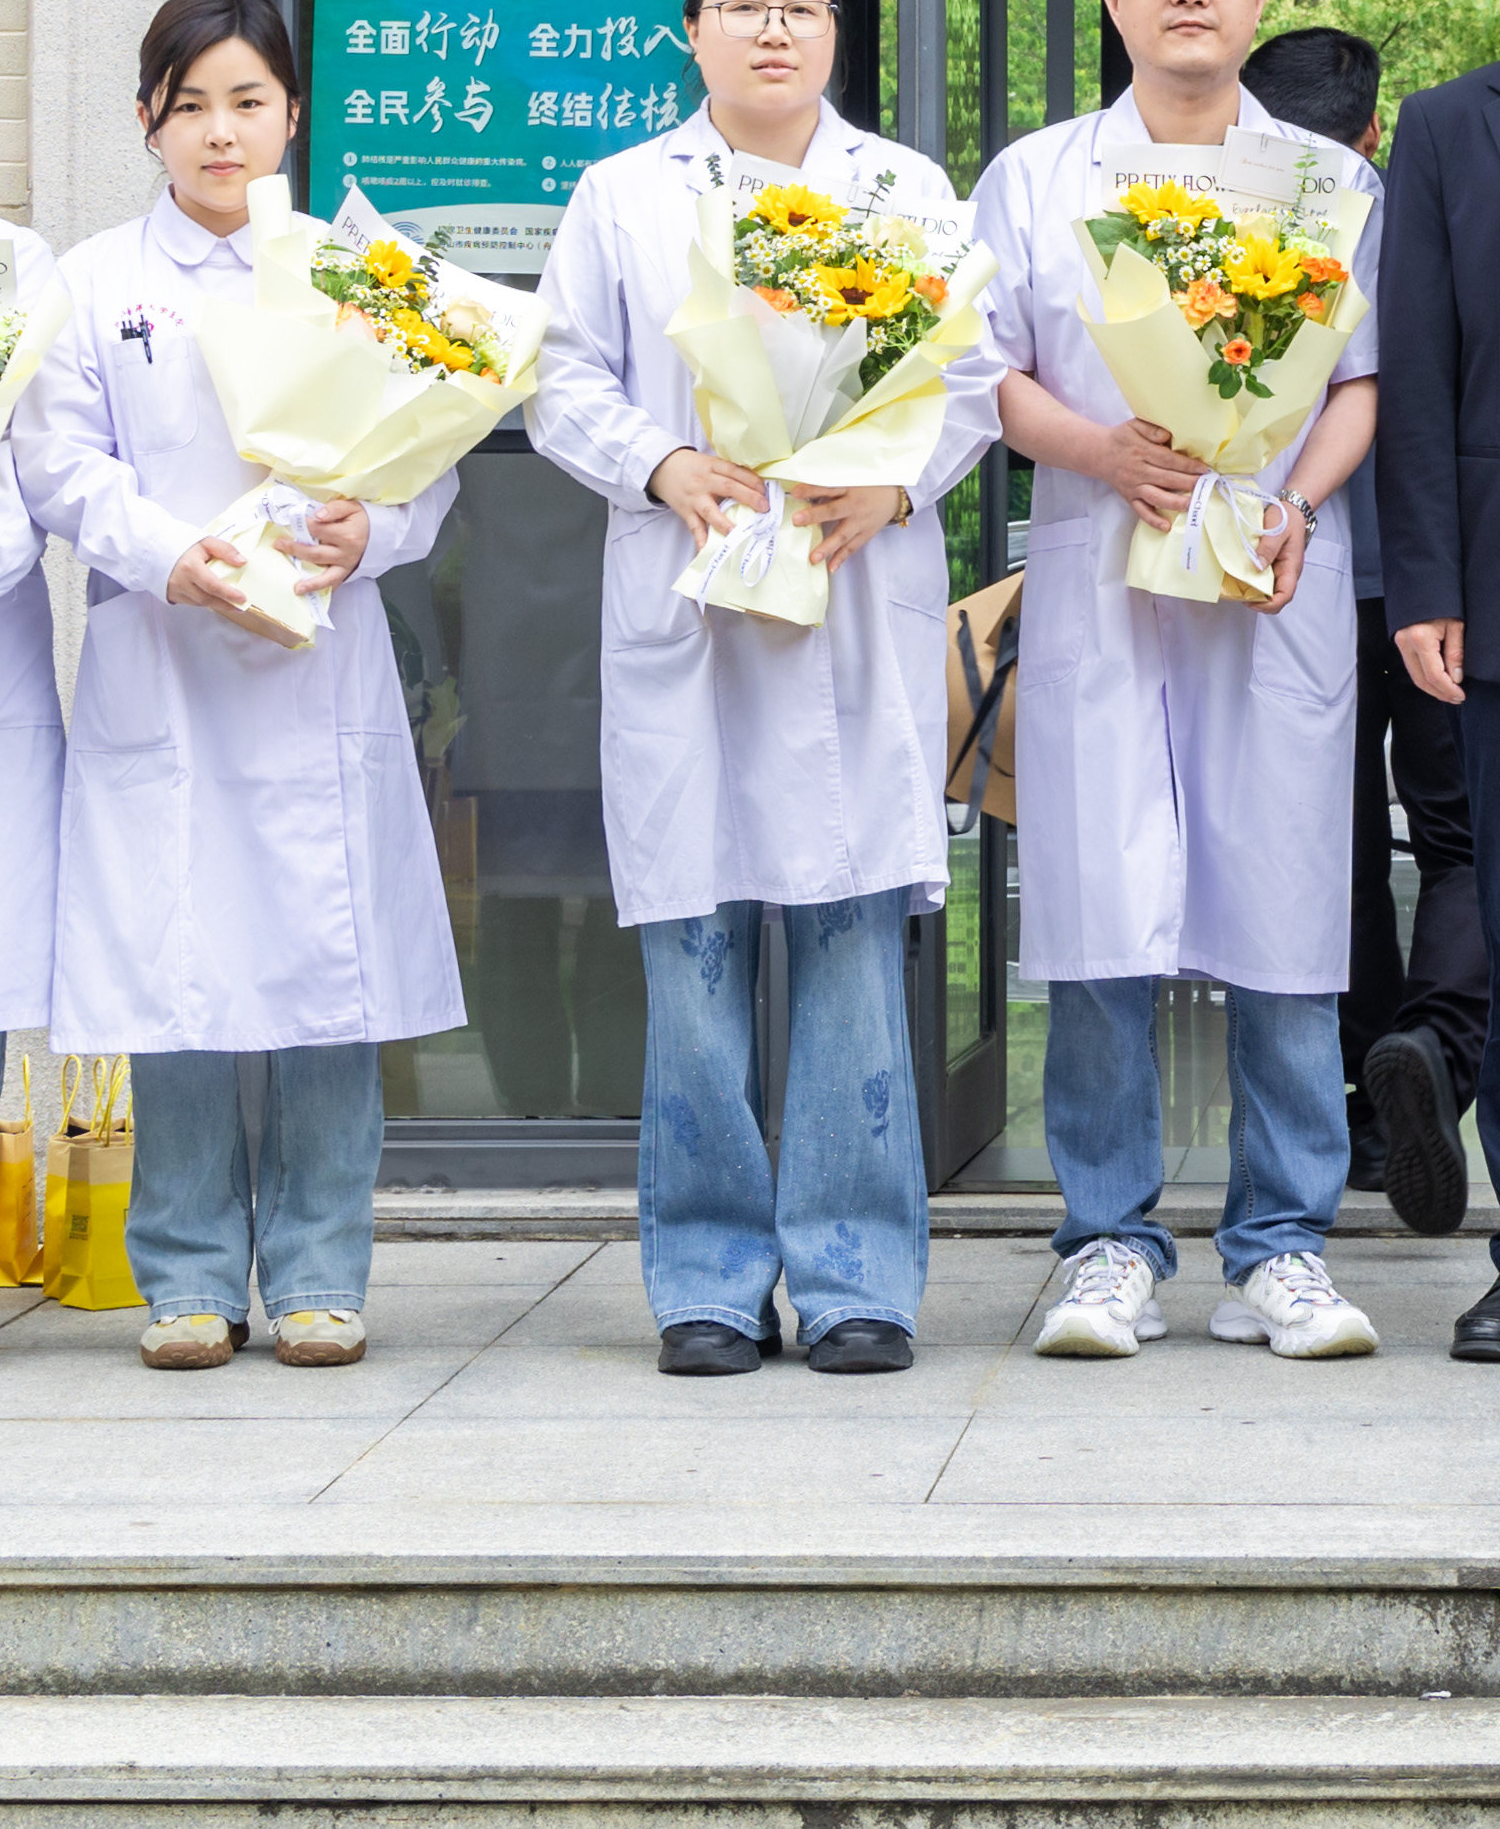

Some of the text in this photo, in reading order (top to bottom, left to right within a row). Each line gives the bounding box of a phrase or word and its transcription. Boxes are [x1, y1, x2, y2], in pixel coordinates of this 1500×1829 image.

[345, 9, 693, 66] 全面行动 全力投入
[344, 76, 686, 133] 全民参与 终结结核
